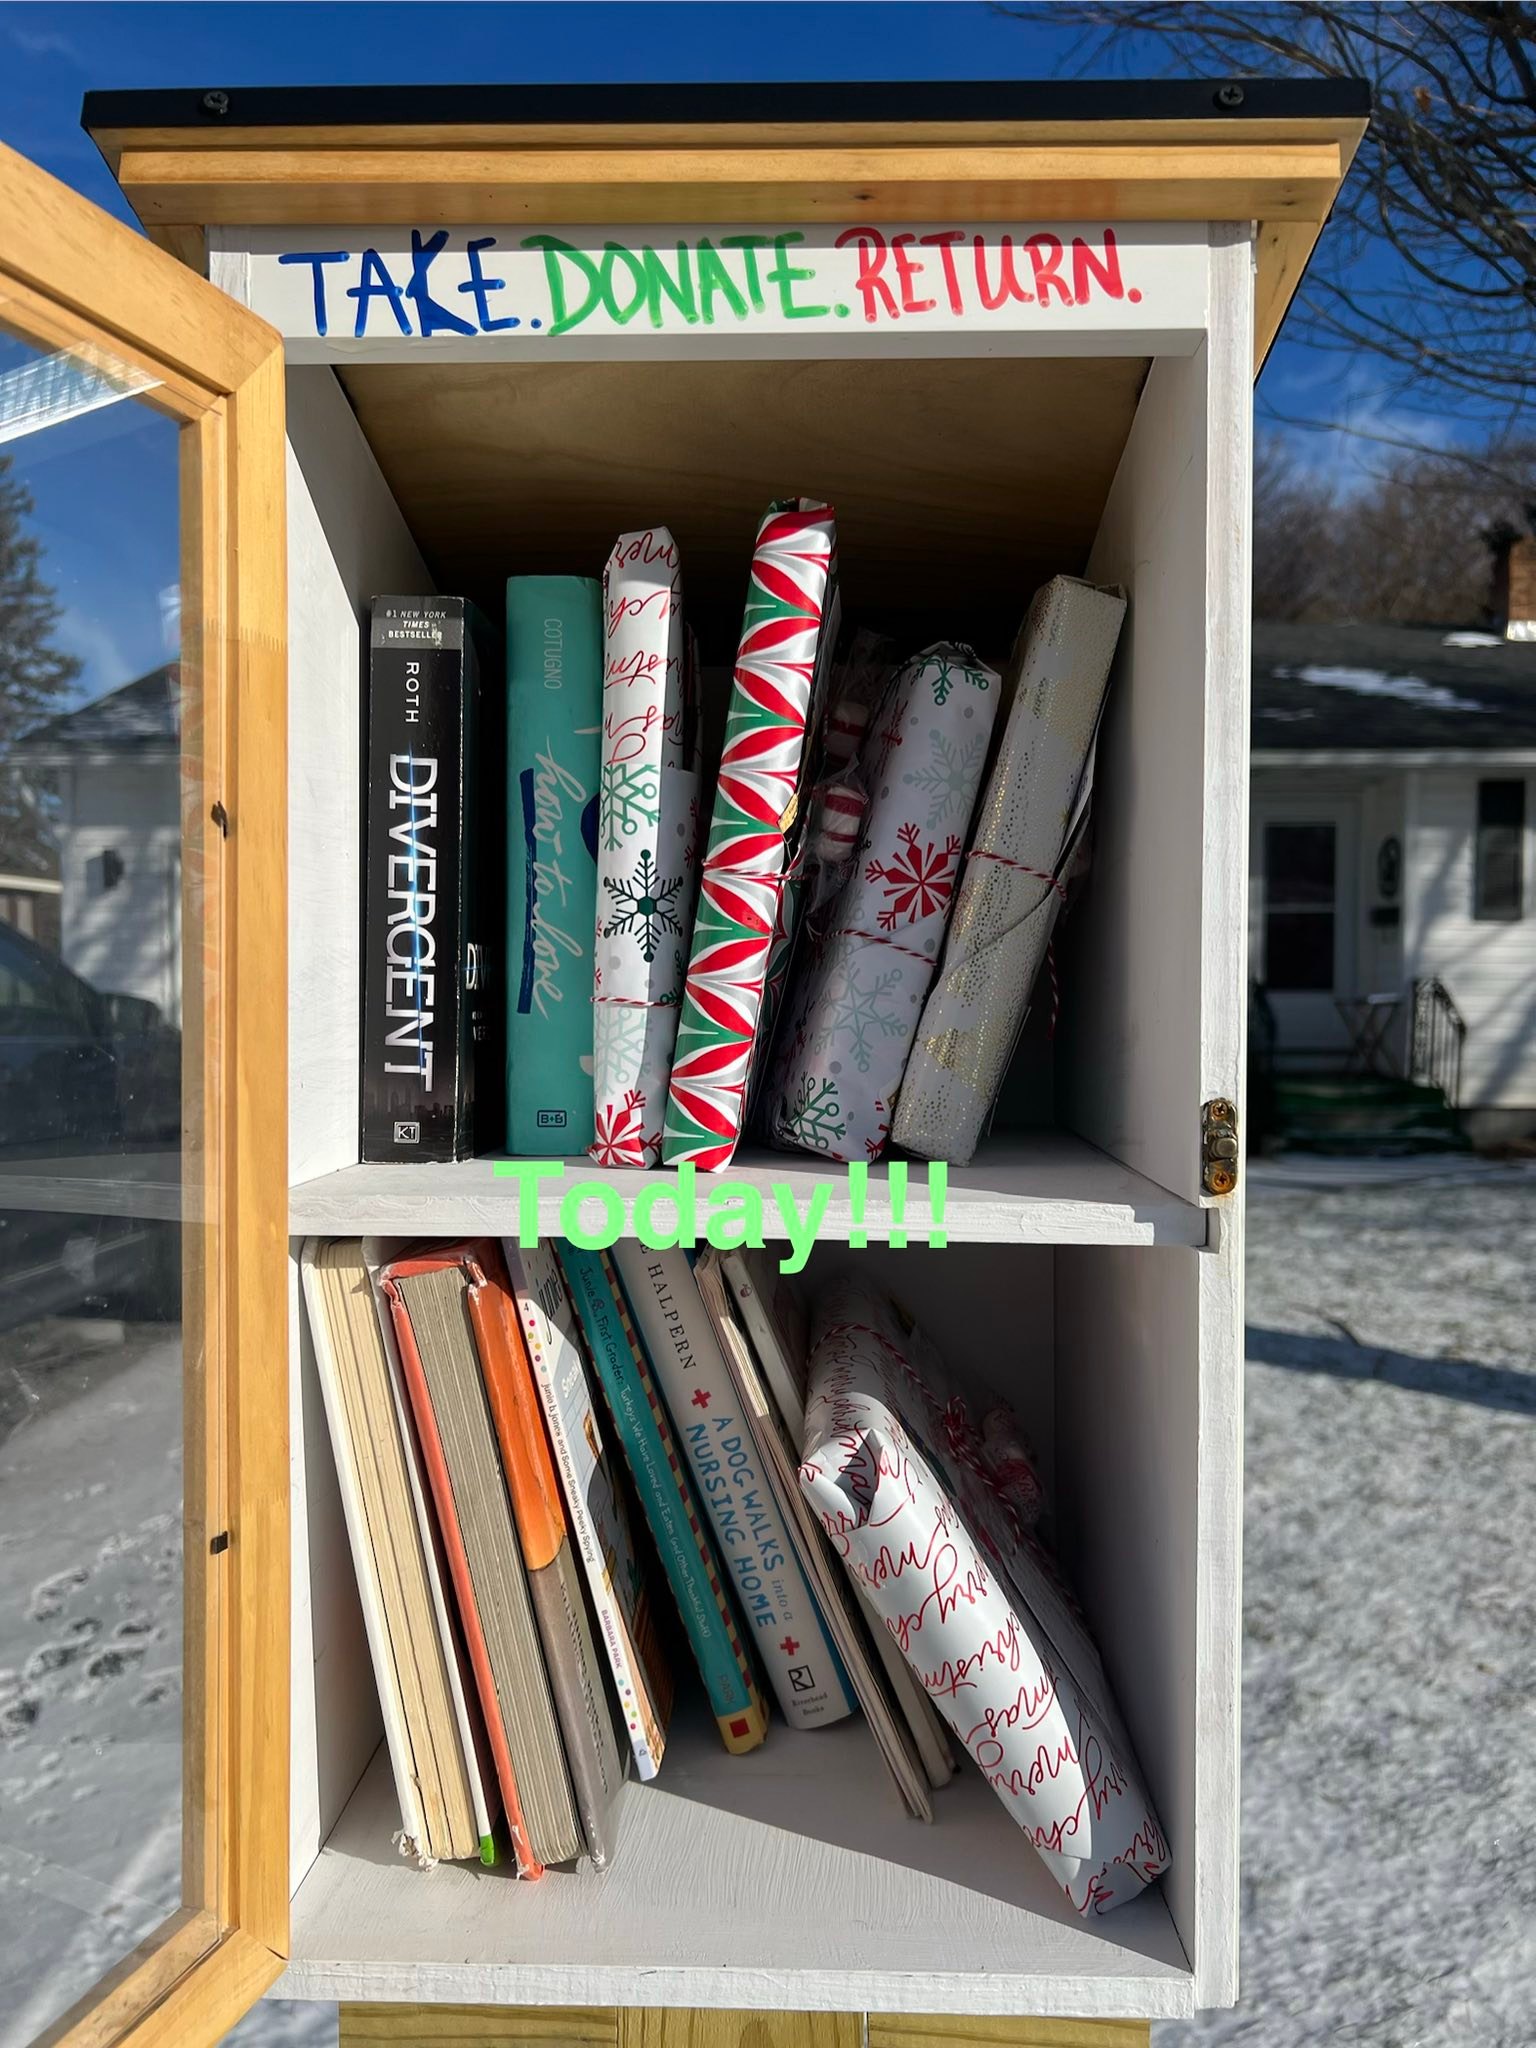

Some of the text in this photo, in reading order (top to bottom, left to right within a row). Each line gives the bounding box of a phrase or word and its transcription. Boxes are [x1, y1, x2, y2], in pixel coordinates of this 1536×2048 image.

[278, 226, 1143, 338] TAKE. DONATE. RETURN.
[400, 611, 420, 619] NEW
[424, 611, 447, 619] YORK
[403, 620, 430, 628] TIMES
[388, 630, 443, 639] BESTSELLER
[543, 618, 563, 690] COTUGNO
[406, 662, 419, 723] ROTH
[529, 735, 587, 1020] how to love
[384, 753, 439, 1092] DIVERGENT
[579, 1266, 596, 1296] Junie
[596, 1315, 612, 1341] First
[647, 1262, 697, 1370] HALPERN
[605, 1342, 624, 1384] Grader:
[541, 1383, 553, 1404] junie
[619, 1386, 636, 1421] Turkeys
[548, 1413, 561, 1436] jones
[632, 1424, 643, 1437] We
[557, 1439, 567, 1454] and
[637, 1437, 650, 1461] Have
[561, 1455, 572, 1477] Some
[645, 1461, 661, 1488] Loved
[565, 1479, 579, 1508] Sneaky
[654, 1491, 667, 1507] and
[573, 1510, 585, 1535] Peeky
[660, 1507, 674, 1534] Eaten
[686, 1423, 778, 1629] NURSING HOME
[711, 1416, 794, 1621] A DOG WALKS into a
[580, 1535, 594, 1562] Spying
[669, 1537, 683, 1554] (and
[675, 1554, 689, 1577] Other
[601, 1609, 621, 1668] BARBARA PARK
